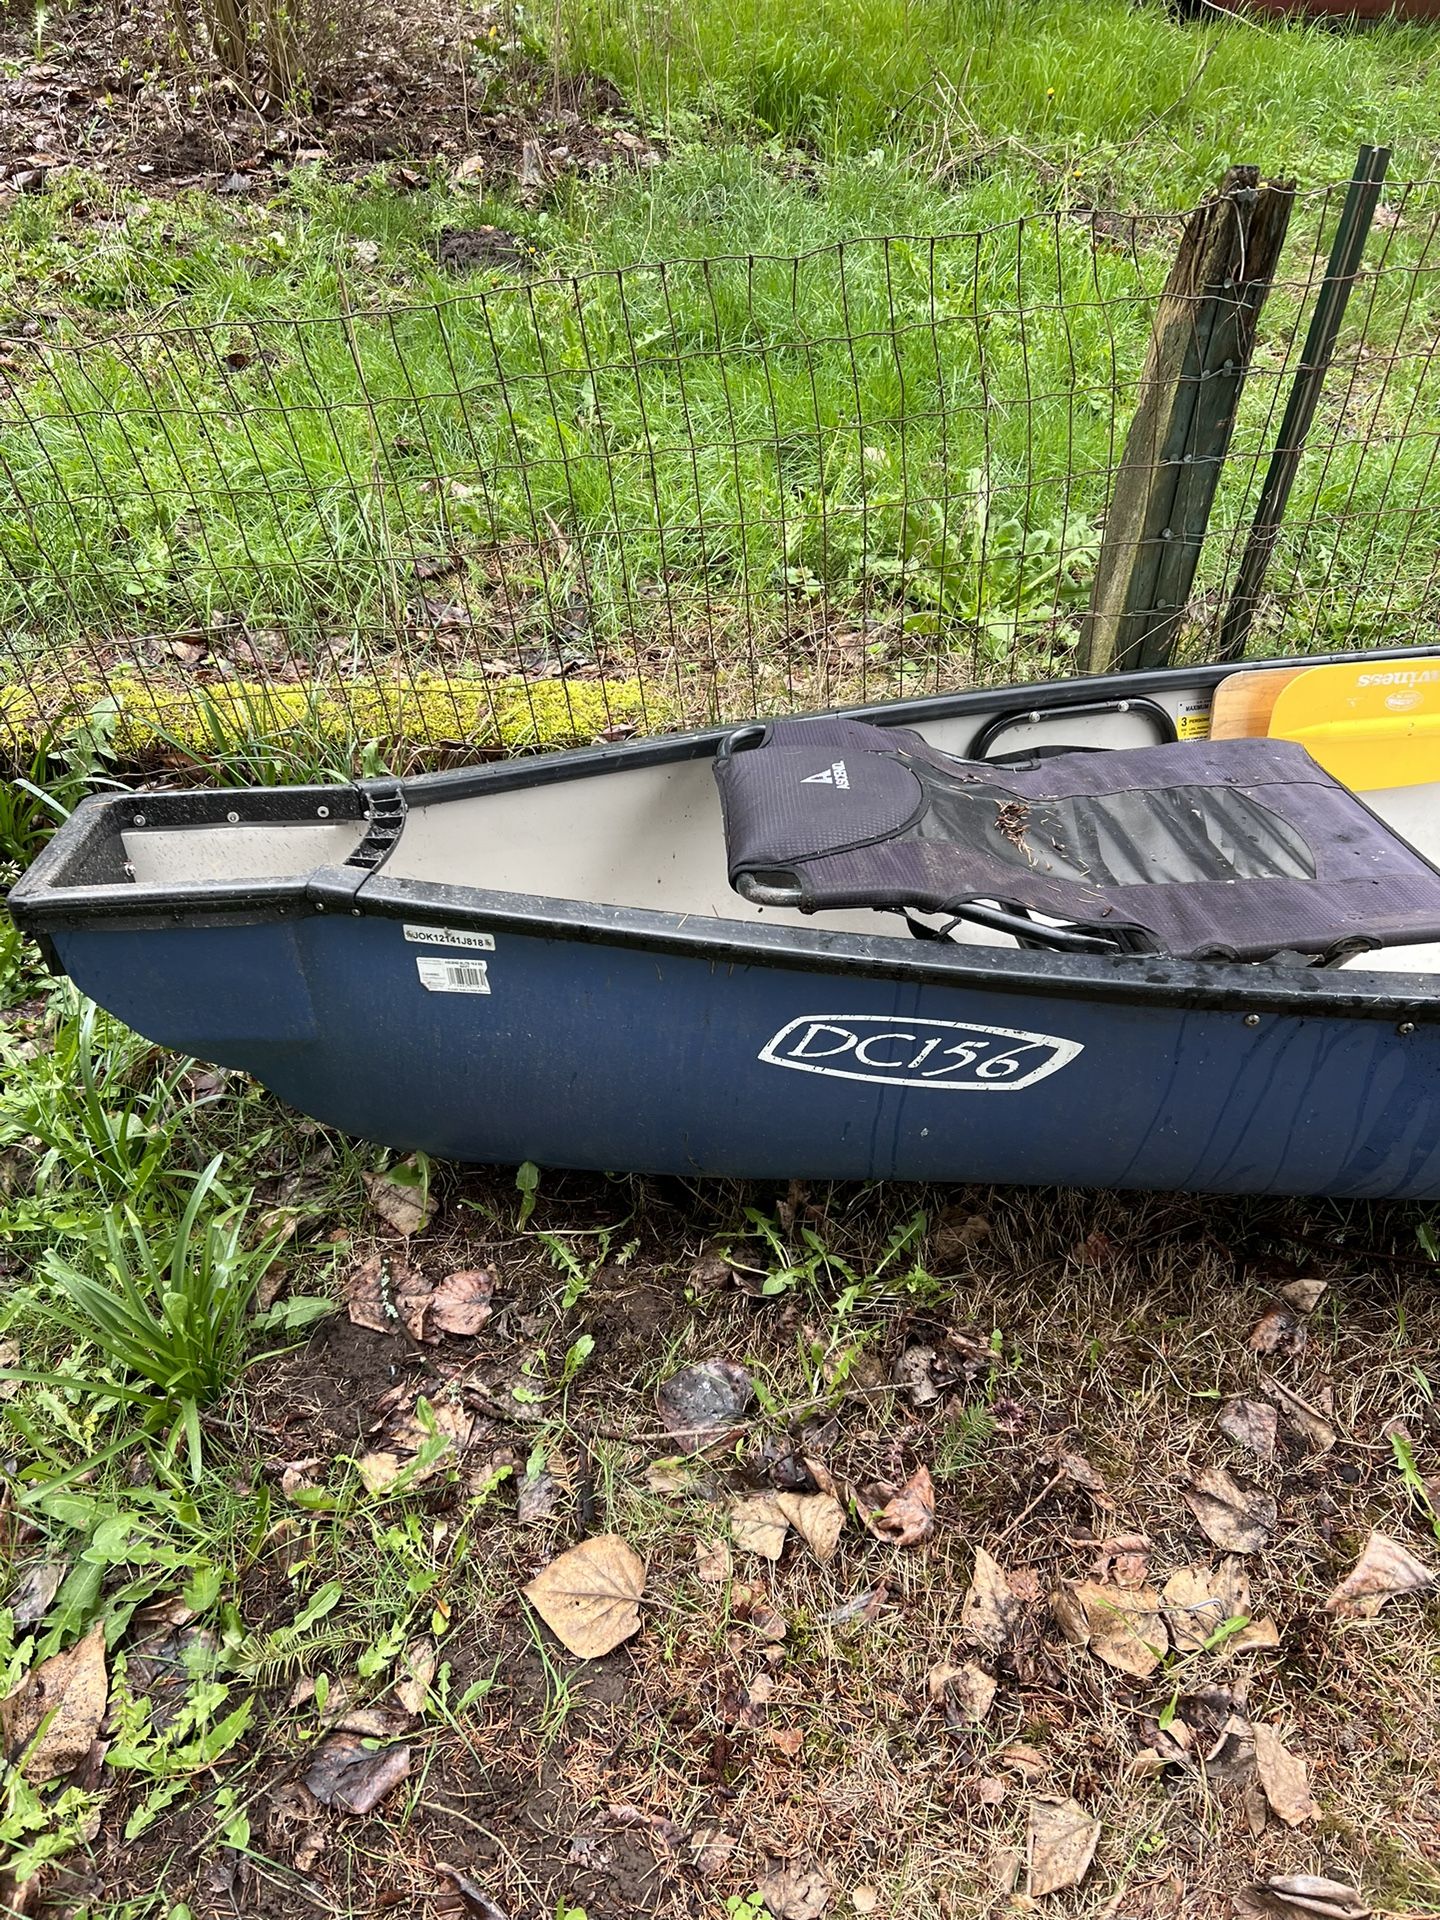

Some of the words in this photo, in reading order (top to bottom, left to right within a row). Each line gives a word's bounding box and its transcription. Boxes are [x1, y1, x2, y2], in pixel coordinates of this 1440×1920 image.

[1181, 717, 1187, 726] 3
[413, 932, 484, 947] JOK12141J818
[787, 1023, 1042, 1078] DC156
